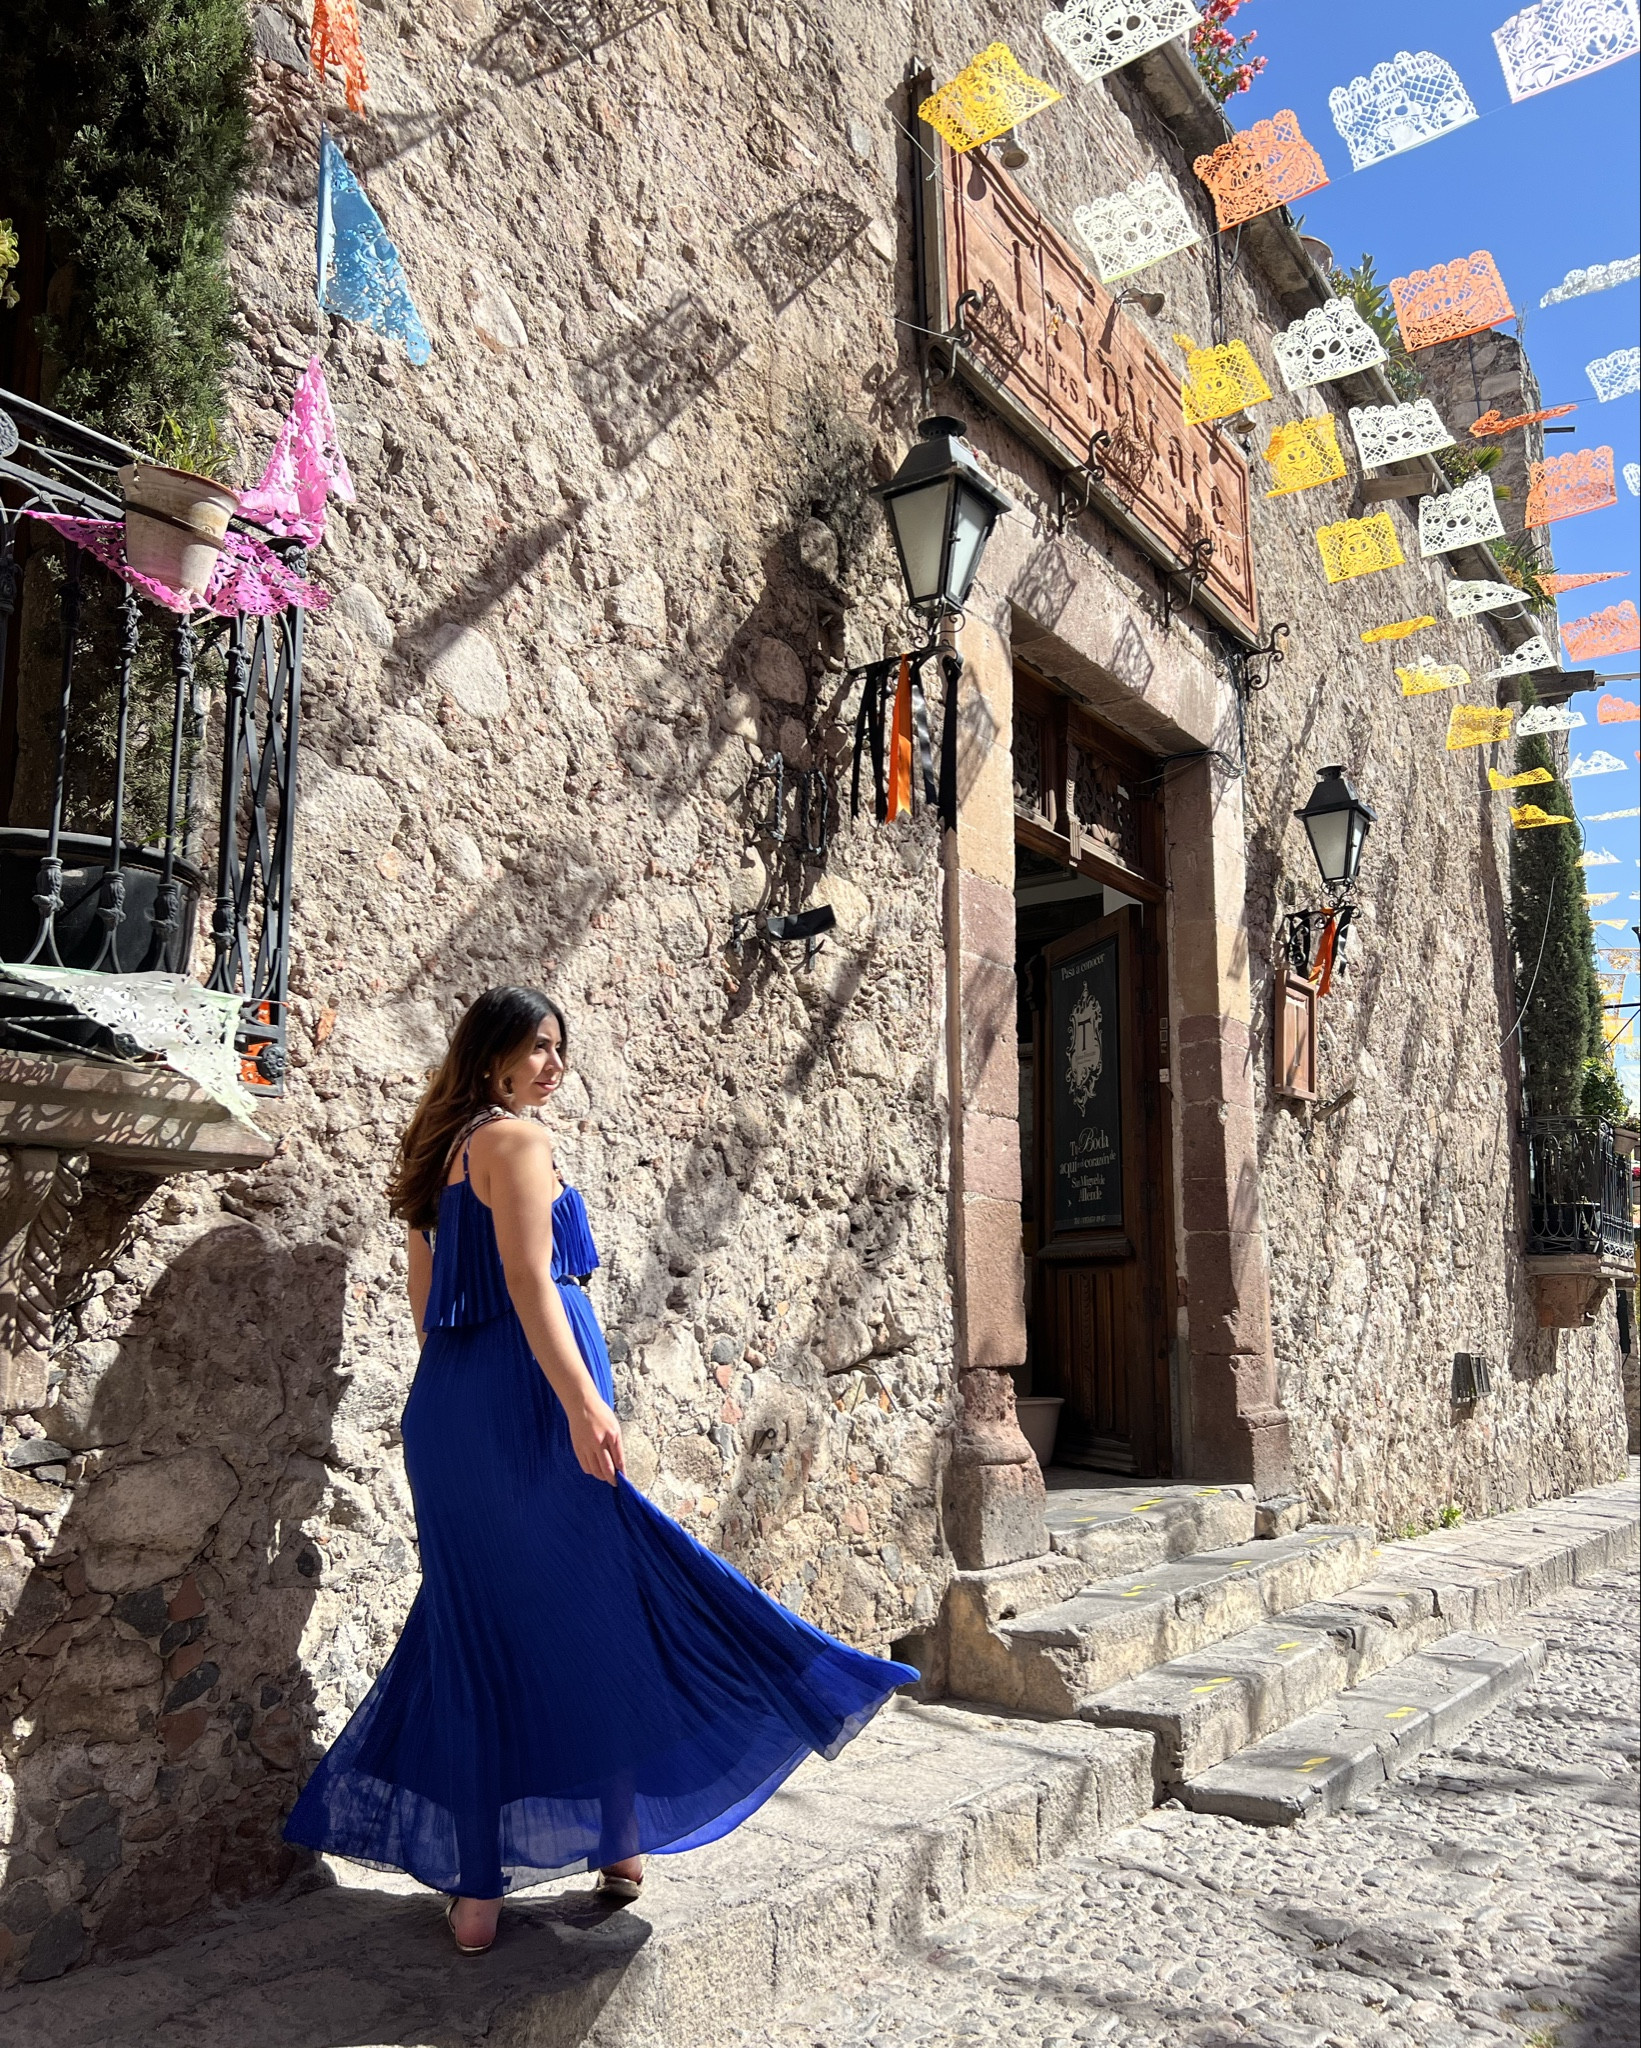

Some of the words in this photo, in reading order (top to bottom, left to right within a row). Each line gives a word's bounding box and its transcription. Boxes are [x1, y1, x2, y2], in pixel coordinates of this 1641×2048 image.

[1086, 393, 1108, 437] DE
[1170, 484, 1178, 511] Y
[1078, 1126, 1109, 1153] Boda
